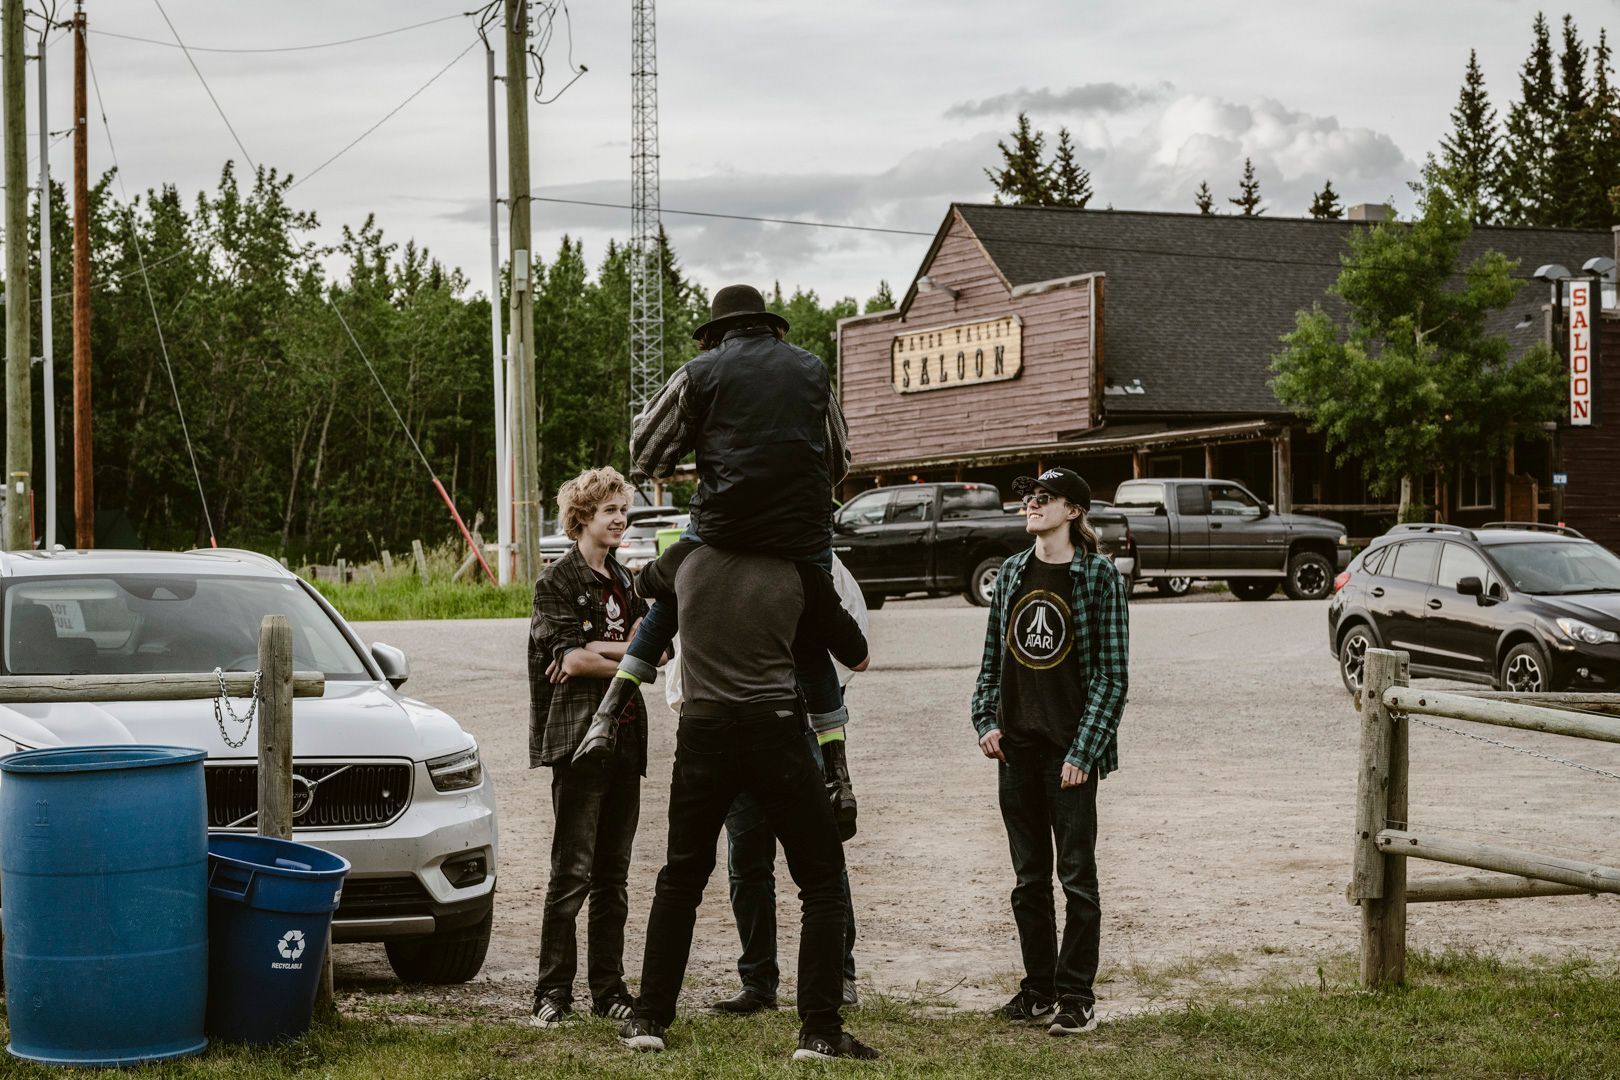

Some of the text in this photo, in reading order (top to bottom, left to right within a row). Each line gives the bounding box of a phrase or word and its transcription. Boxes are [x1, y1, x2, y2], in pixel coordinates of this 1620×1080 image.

[955, 320, 1011, 344] VALLEY
[903, 345, 1005, 388] SALOON
[1572, 288, 1589, 418] SALOON
[1025, 634, 1054, 649] ATARI
